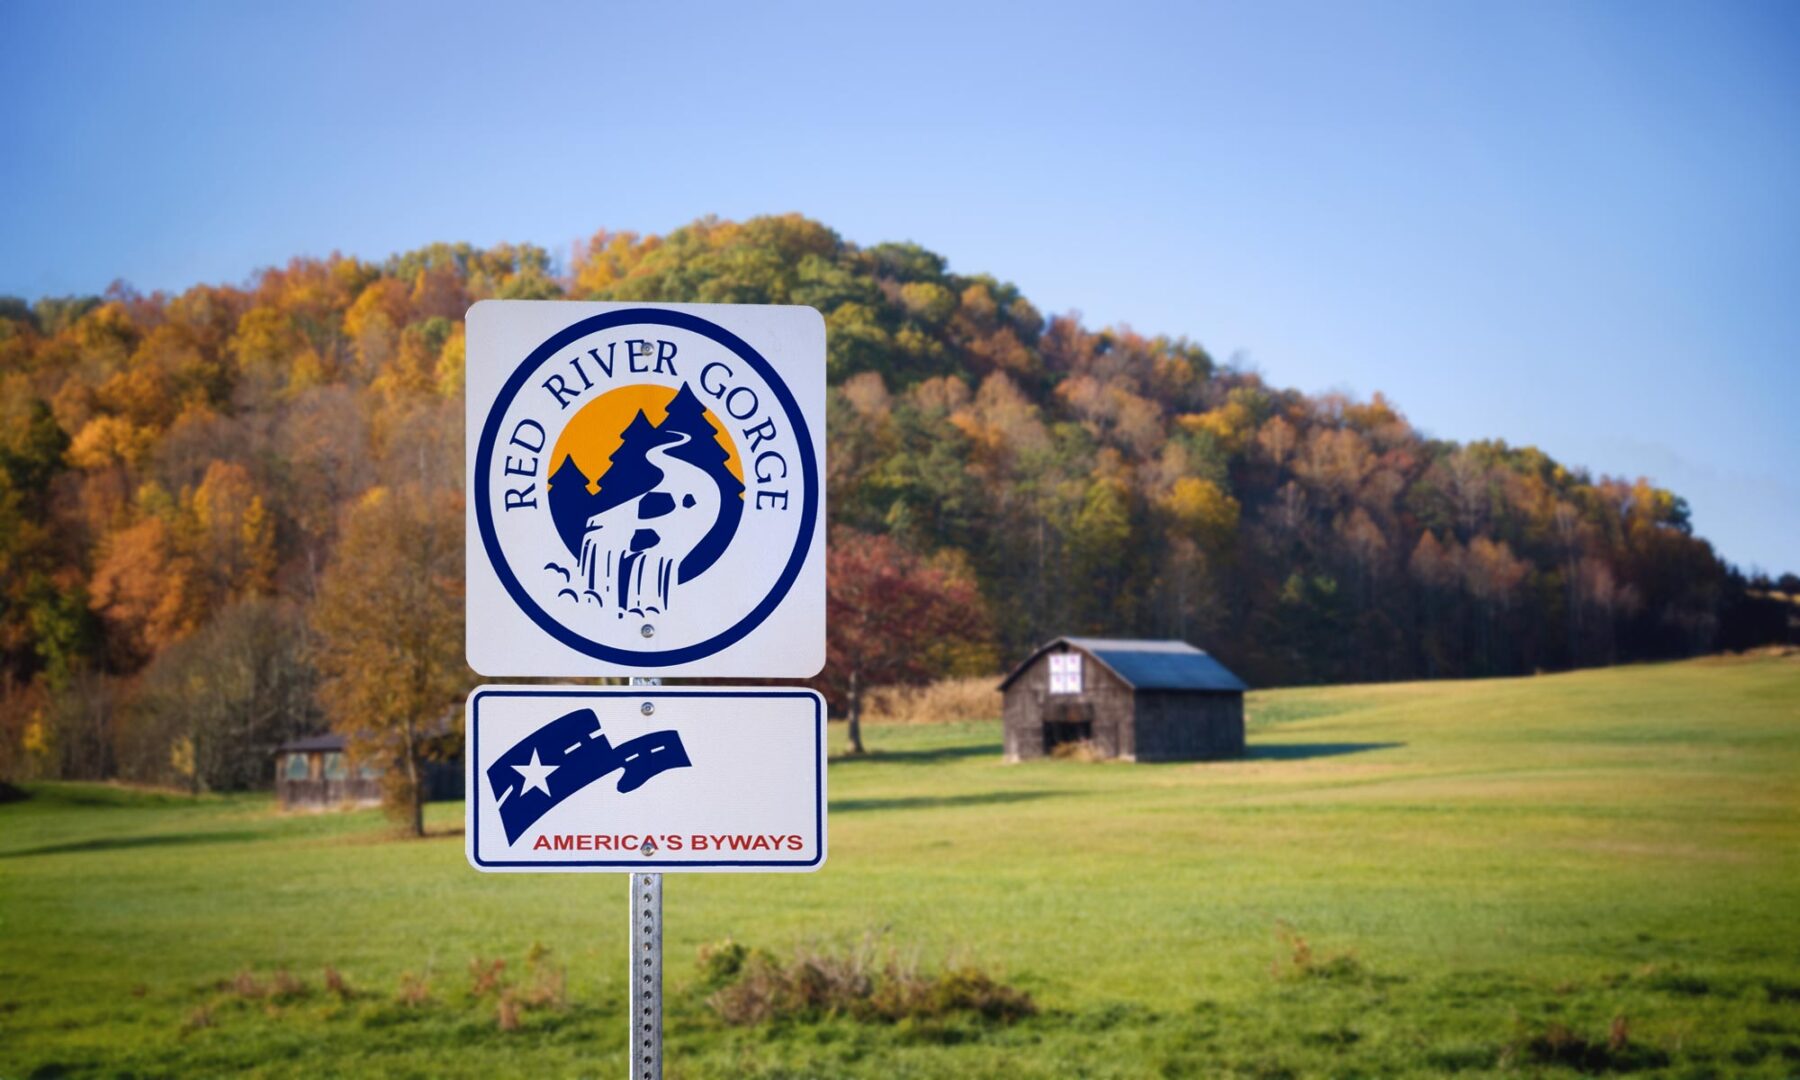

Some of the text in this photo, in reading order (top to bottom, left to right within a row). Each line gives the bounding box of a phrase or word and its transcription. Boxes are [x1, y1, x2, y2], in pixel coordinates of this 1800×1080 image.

[504, 339, 789, 513] RED RIVER GORGE
[533, 834, 804, 851] AMERICA'S BYWAYS
